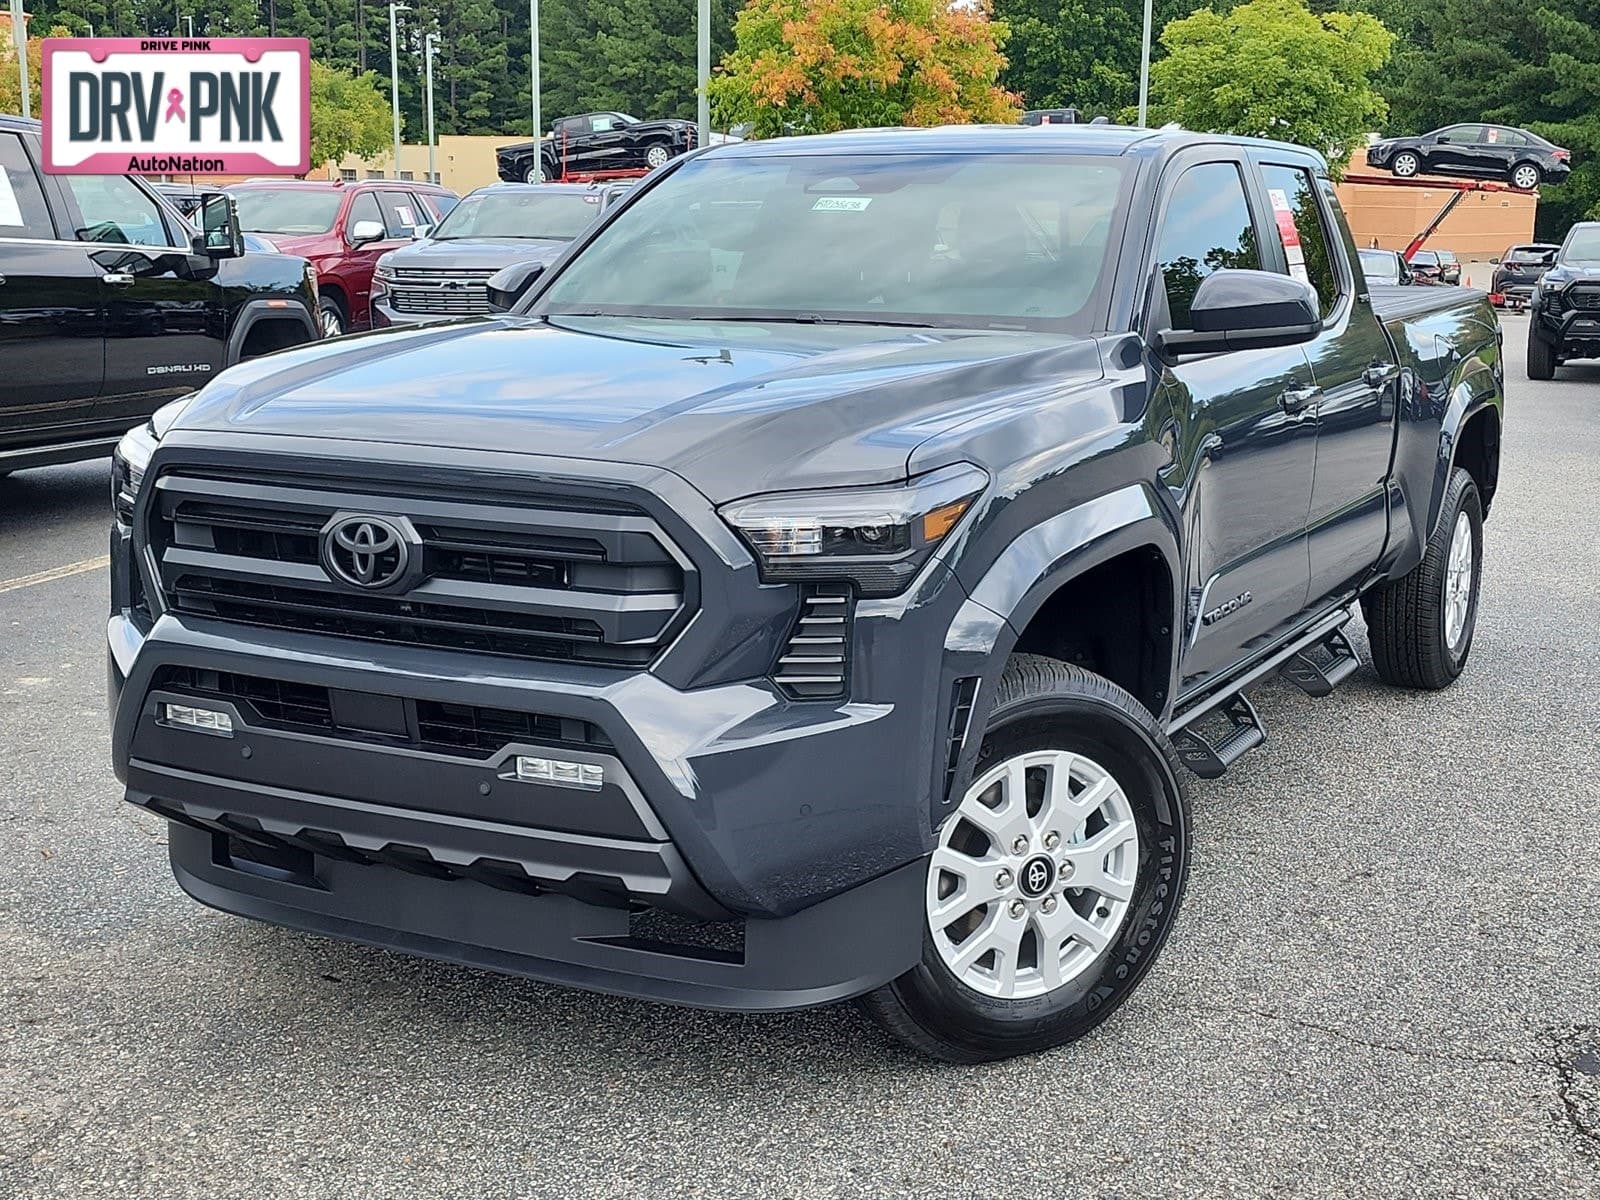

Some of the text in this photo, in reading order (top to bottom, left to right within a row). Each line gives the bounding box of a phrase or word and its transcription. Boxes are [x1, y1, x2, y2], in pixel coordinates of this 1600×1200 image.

[147, 364, 211, 375] DENALI HD
[1203, 591, 1252, 625] TACOMA
[1115, 834, 1176, 980] Firestone
